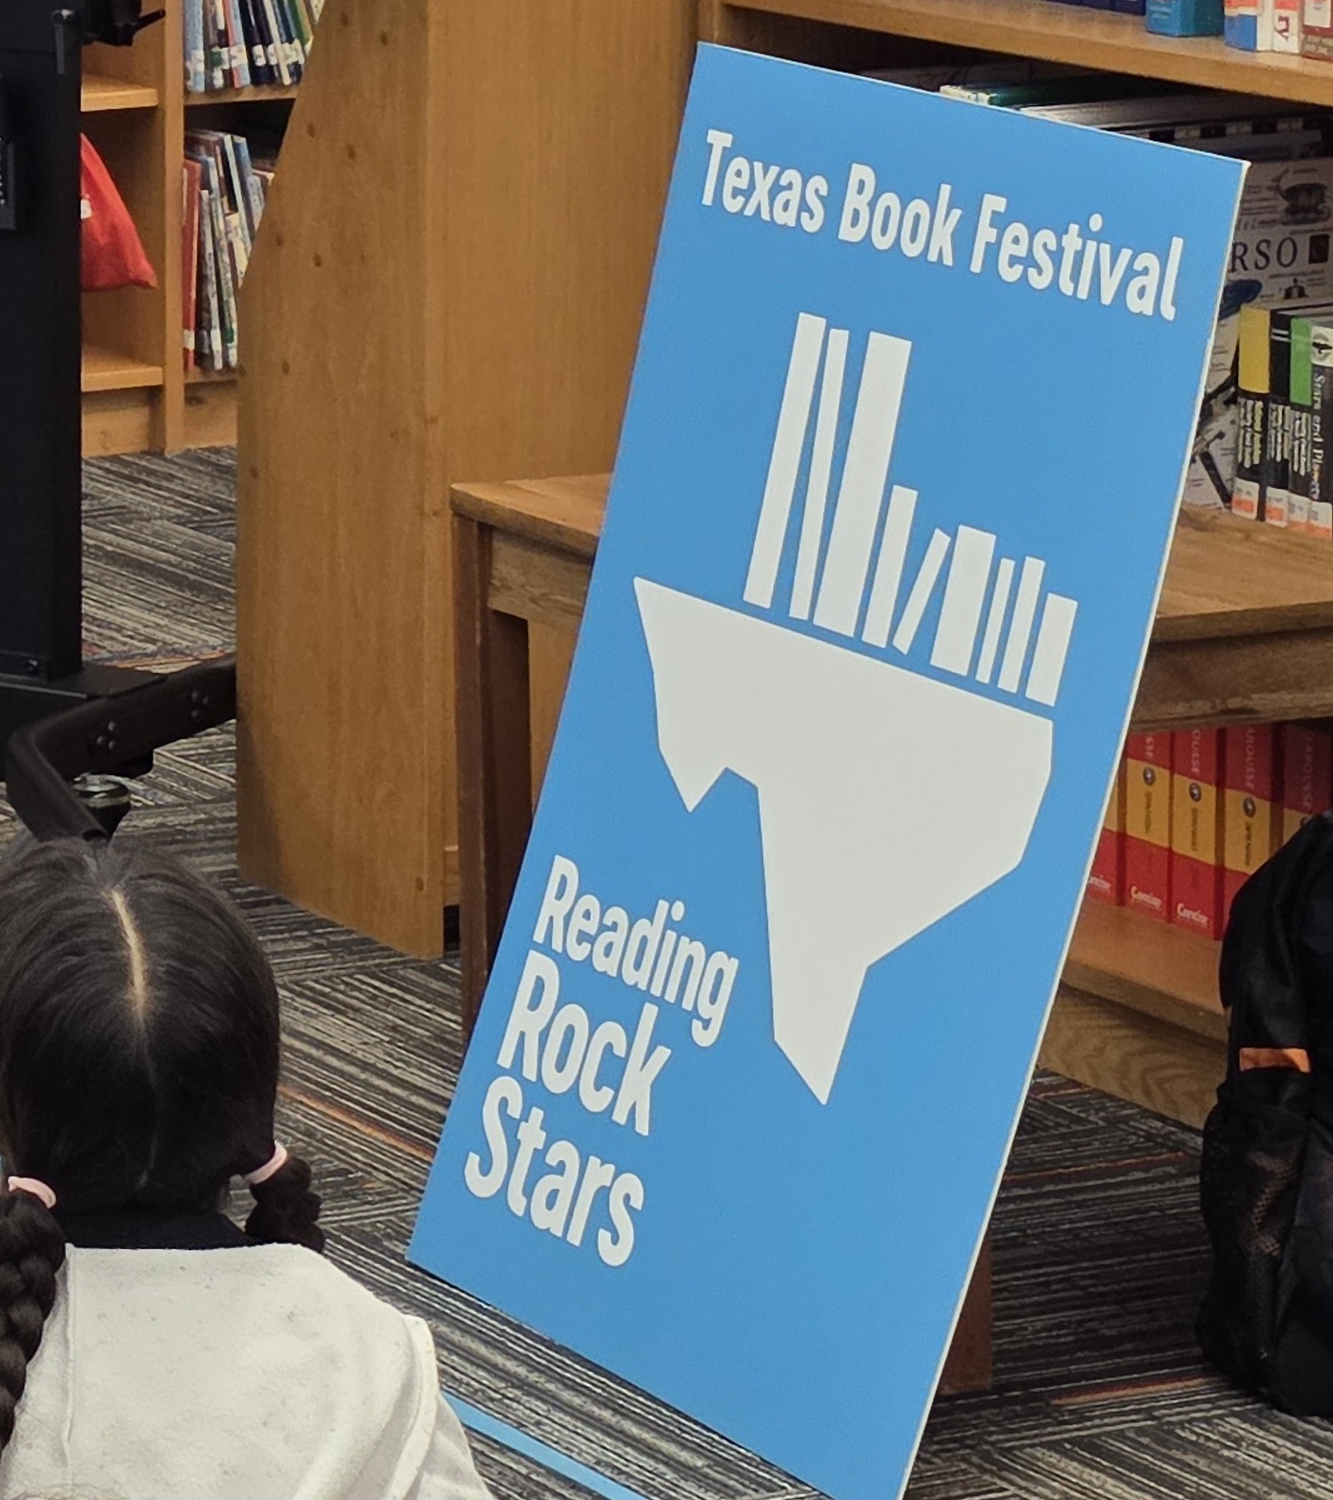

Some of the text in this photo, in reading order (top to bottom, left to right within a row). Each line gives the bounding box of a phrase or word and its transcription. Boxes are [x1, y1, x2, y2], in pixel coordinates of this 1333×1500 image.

[701, 129, 1185, 321] Texas Book Festival
[1191, 728, 1202, 774] OUSSE
[1245, 727, 1255, 790] AROUSSE
[533, 854, 739, 1048] Reading
[464, 1075, 644, 1267] Stars
